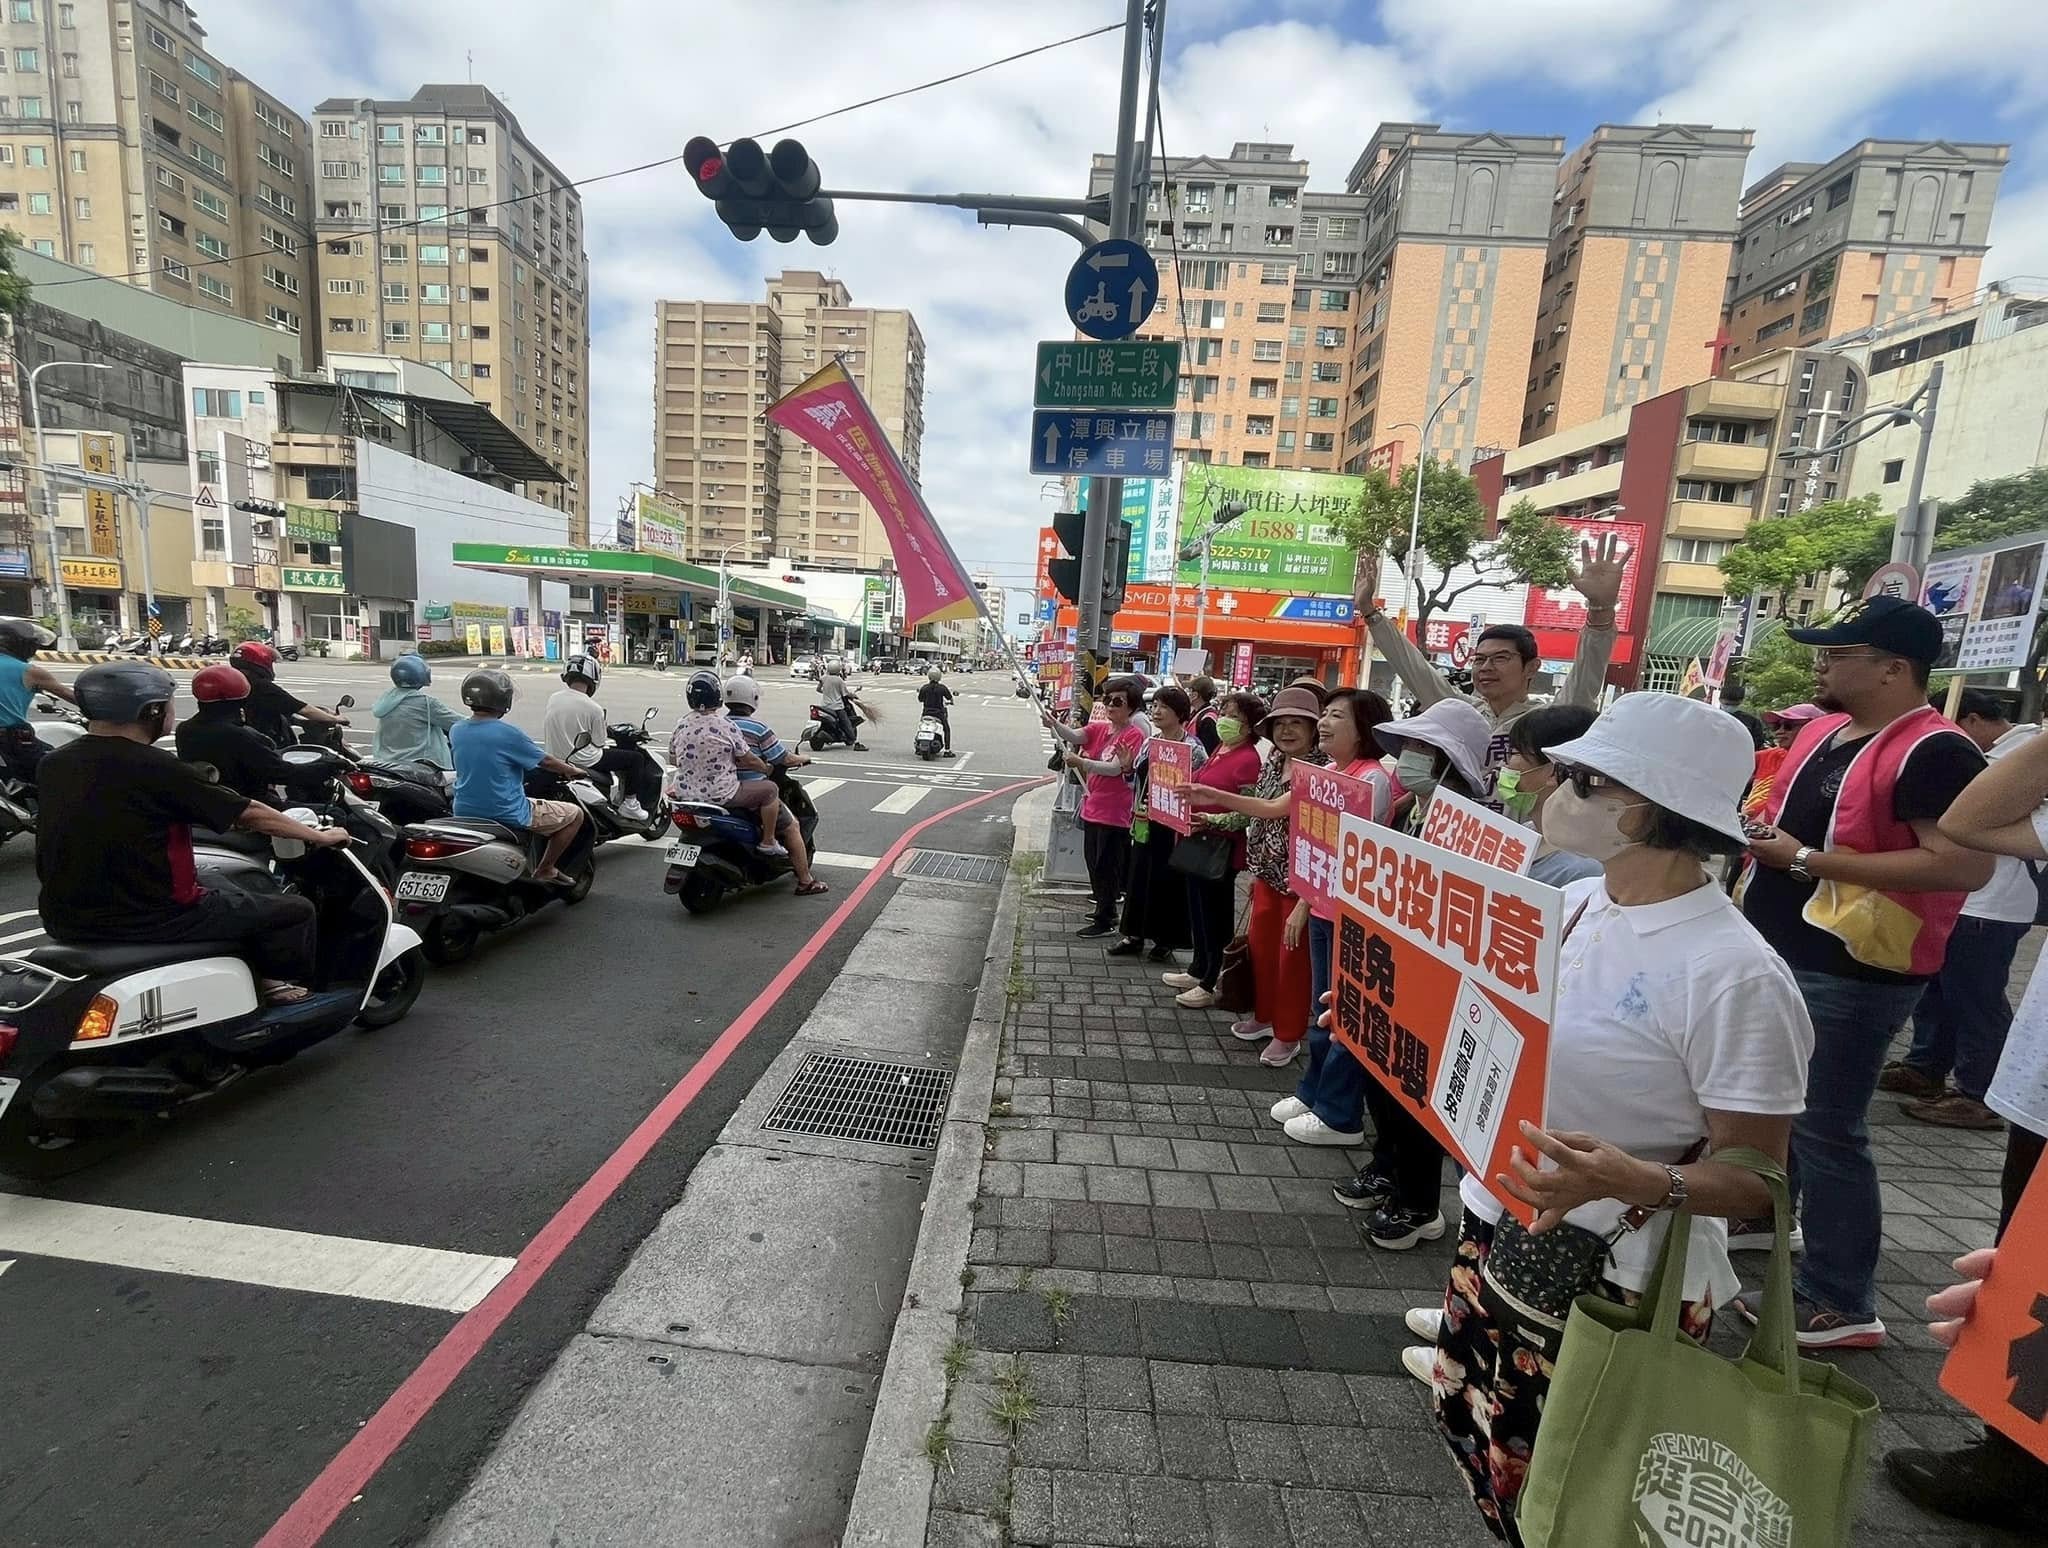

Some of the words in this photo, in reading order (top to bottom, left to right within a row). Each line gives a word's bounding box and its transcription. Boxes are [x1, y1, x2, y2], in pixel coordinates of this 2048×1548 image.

[1055, 347, 1160, 377] 中山路二段
[1054, 382, 1105, 401] Zhongshan
[1111, 383, 1124, 398] Rd.
[1131, 381, 1158, 398] Sec.2
[1070, 418, 1167, 441] 潭興立體
[1068, 447, 1164, 471] 停車場
[89, 455, 110, 537] 明工藝行
[287, 525, 337, 543] 2535-1234
[1249, 519, 1296, 540] 1588
[1201, 545, 1271, 560] 522-5717
[1425, 622, 1449, 649] 鞋
[1310, 775, 1345, 811] 8月23日
[1423, 799, 1527, 877] 823投同意
[399, 881, 446, 897] G5T-630
[1341, 831, 1544, 995] 823投同意
[1339, 912, 1396, 1008] 罷免
[1336, 975, 1430, 1110] 楊瓊瓔
[1444, 1027, 1477, 1123] 同意罷免
[1475, 1061, 1502, 1134] 不同意罷免
[1651, 1432, 1709, 1463] TEAM
[1712, 1441, 1793, 1518] TAIWAN
